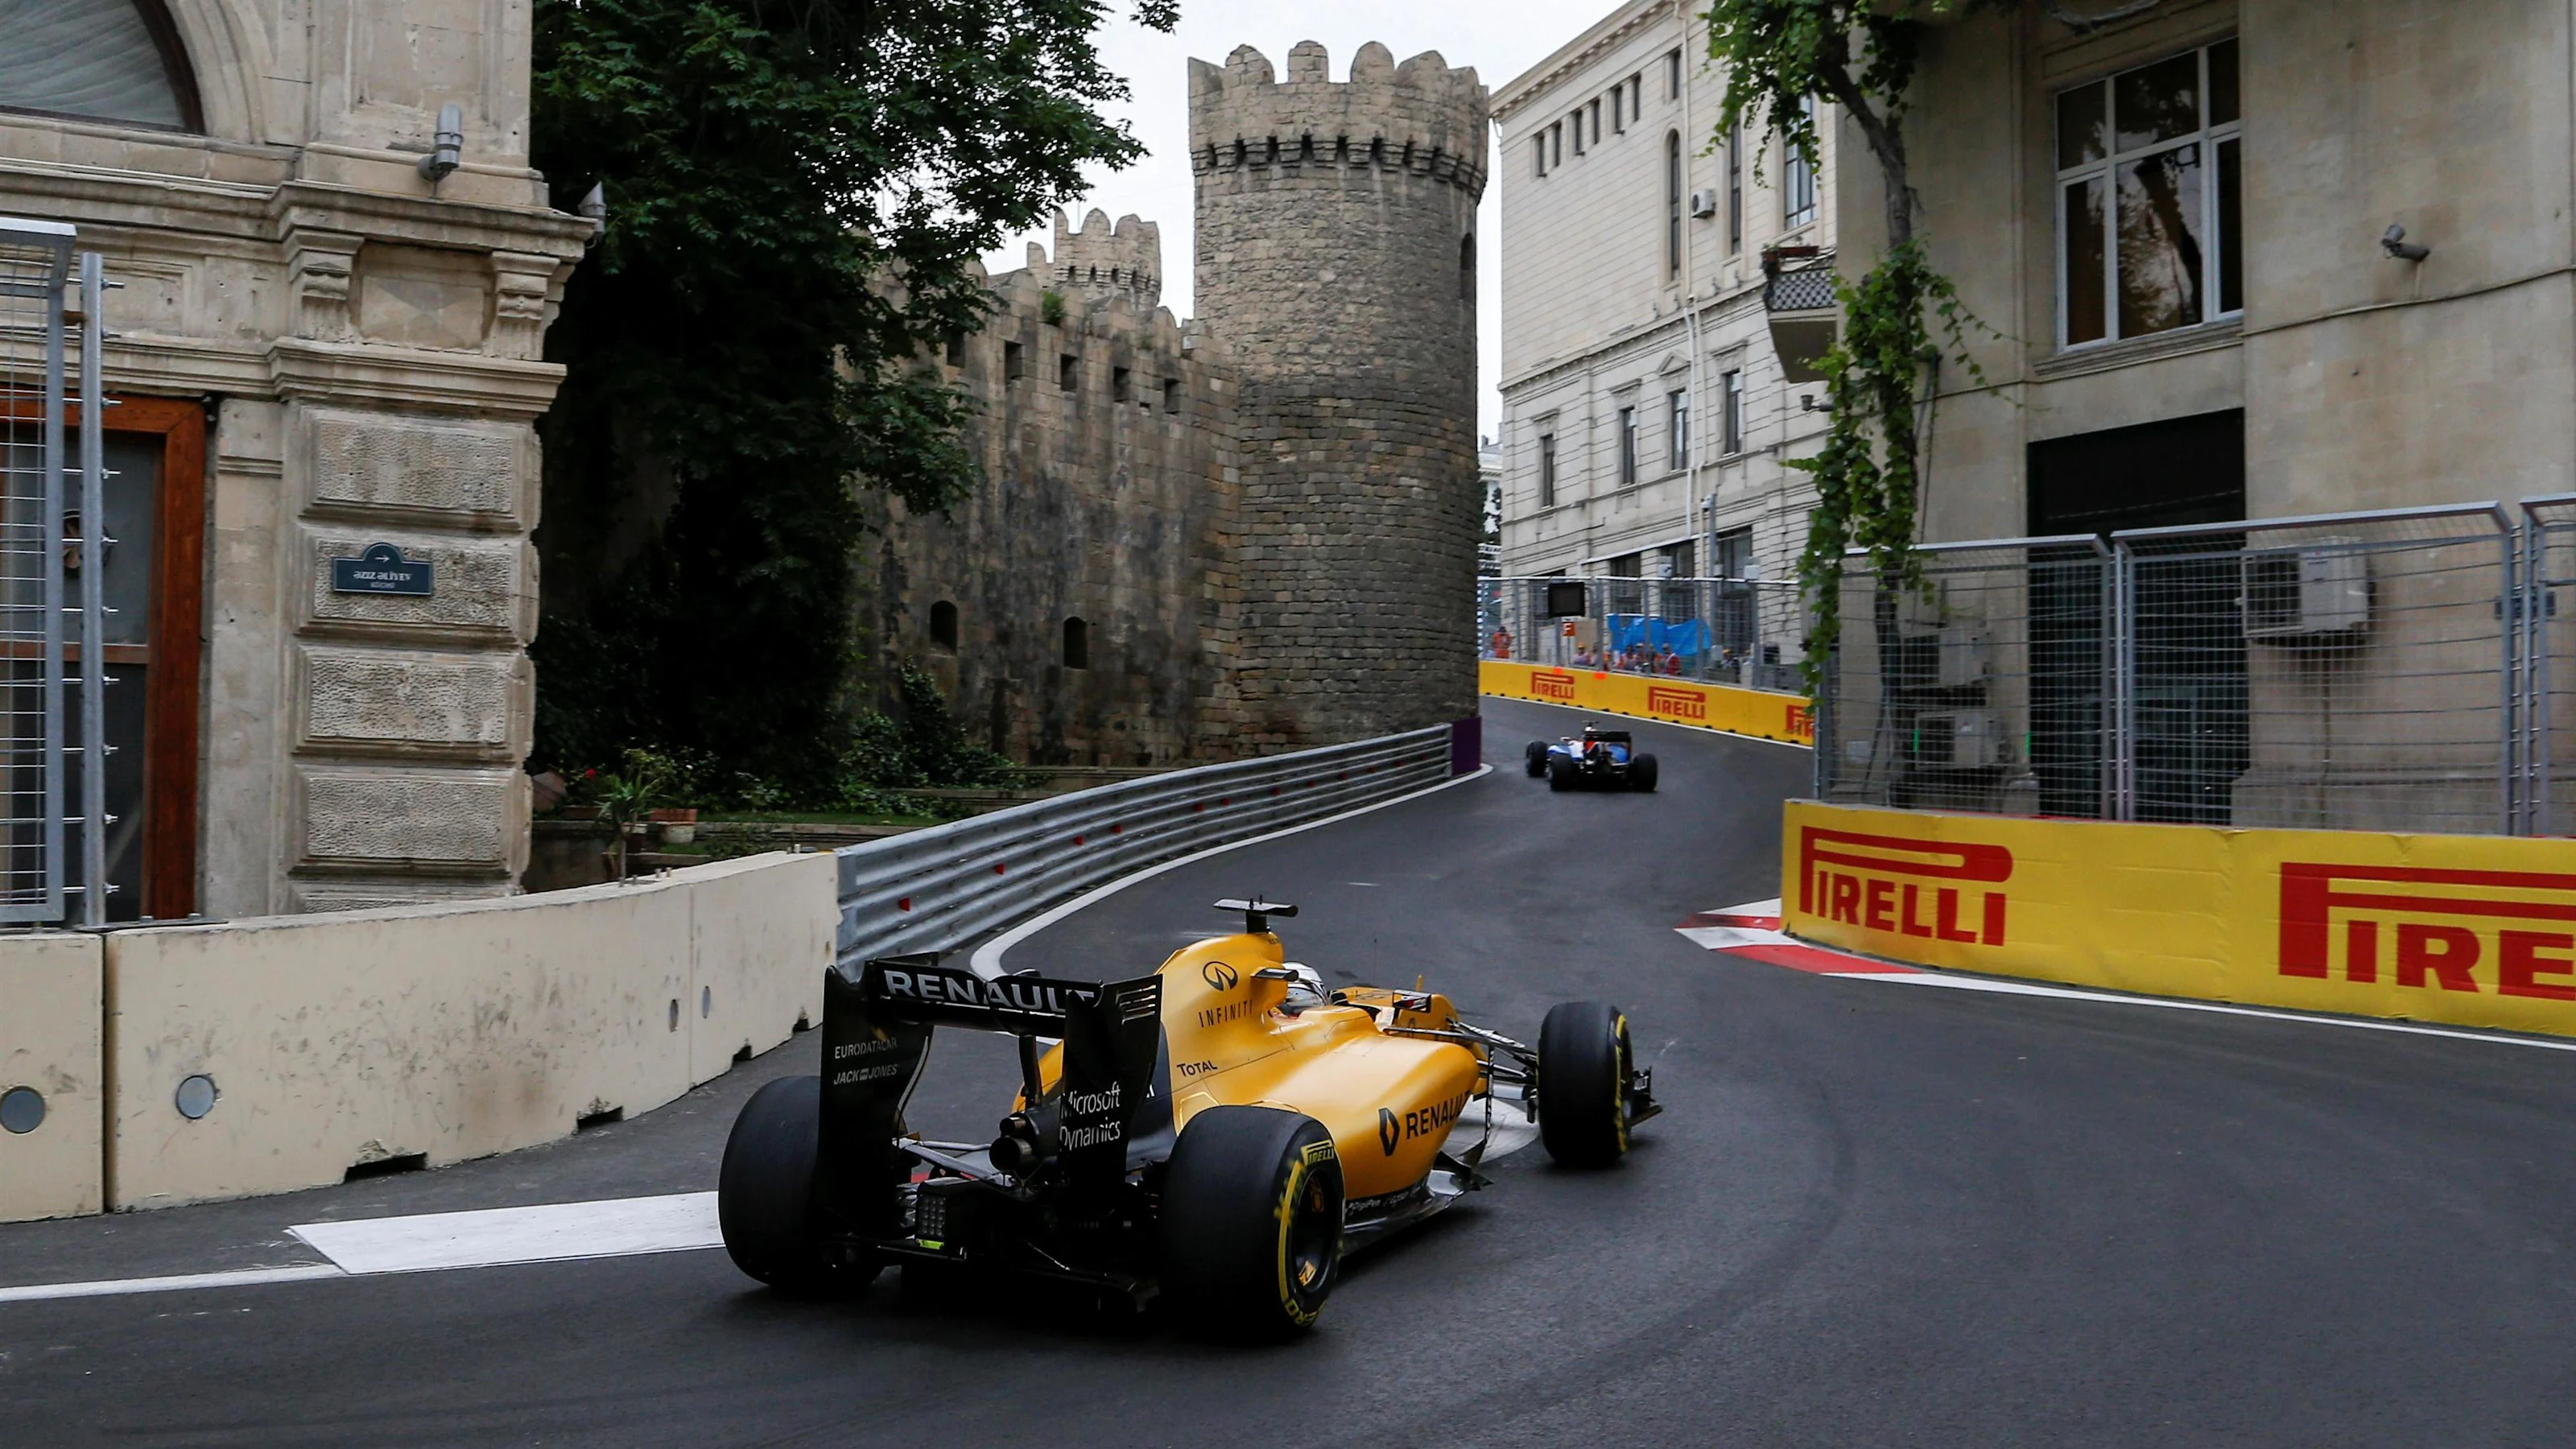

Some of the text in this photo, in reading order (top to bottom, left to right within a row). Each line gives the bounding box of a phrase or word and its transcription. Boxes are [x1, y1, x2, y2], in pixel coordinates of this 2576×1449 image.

[1531, 671, 1575, 700] PIRELLI
[1648, 686, 1706, 720] PIRELLI
[1799, 825, 2013, 946] PIRELLI
[1198, 999, 1253, 1028] INFINITI
[834, 1037, 898, 1059] EURODATACAR
[1059, 1117, 1121, 1151] Dynamics
[1300, 1139, 1334, 1166] PIRELLI
